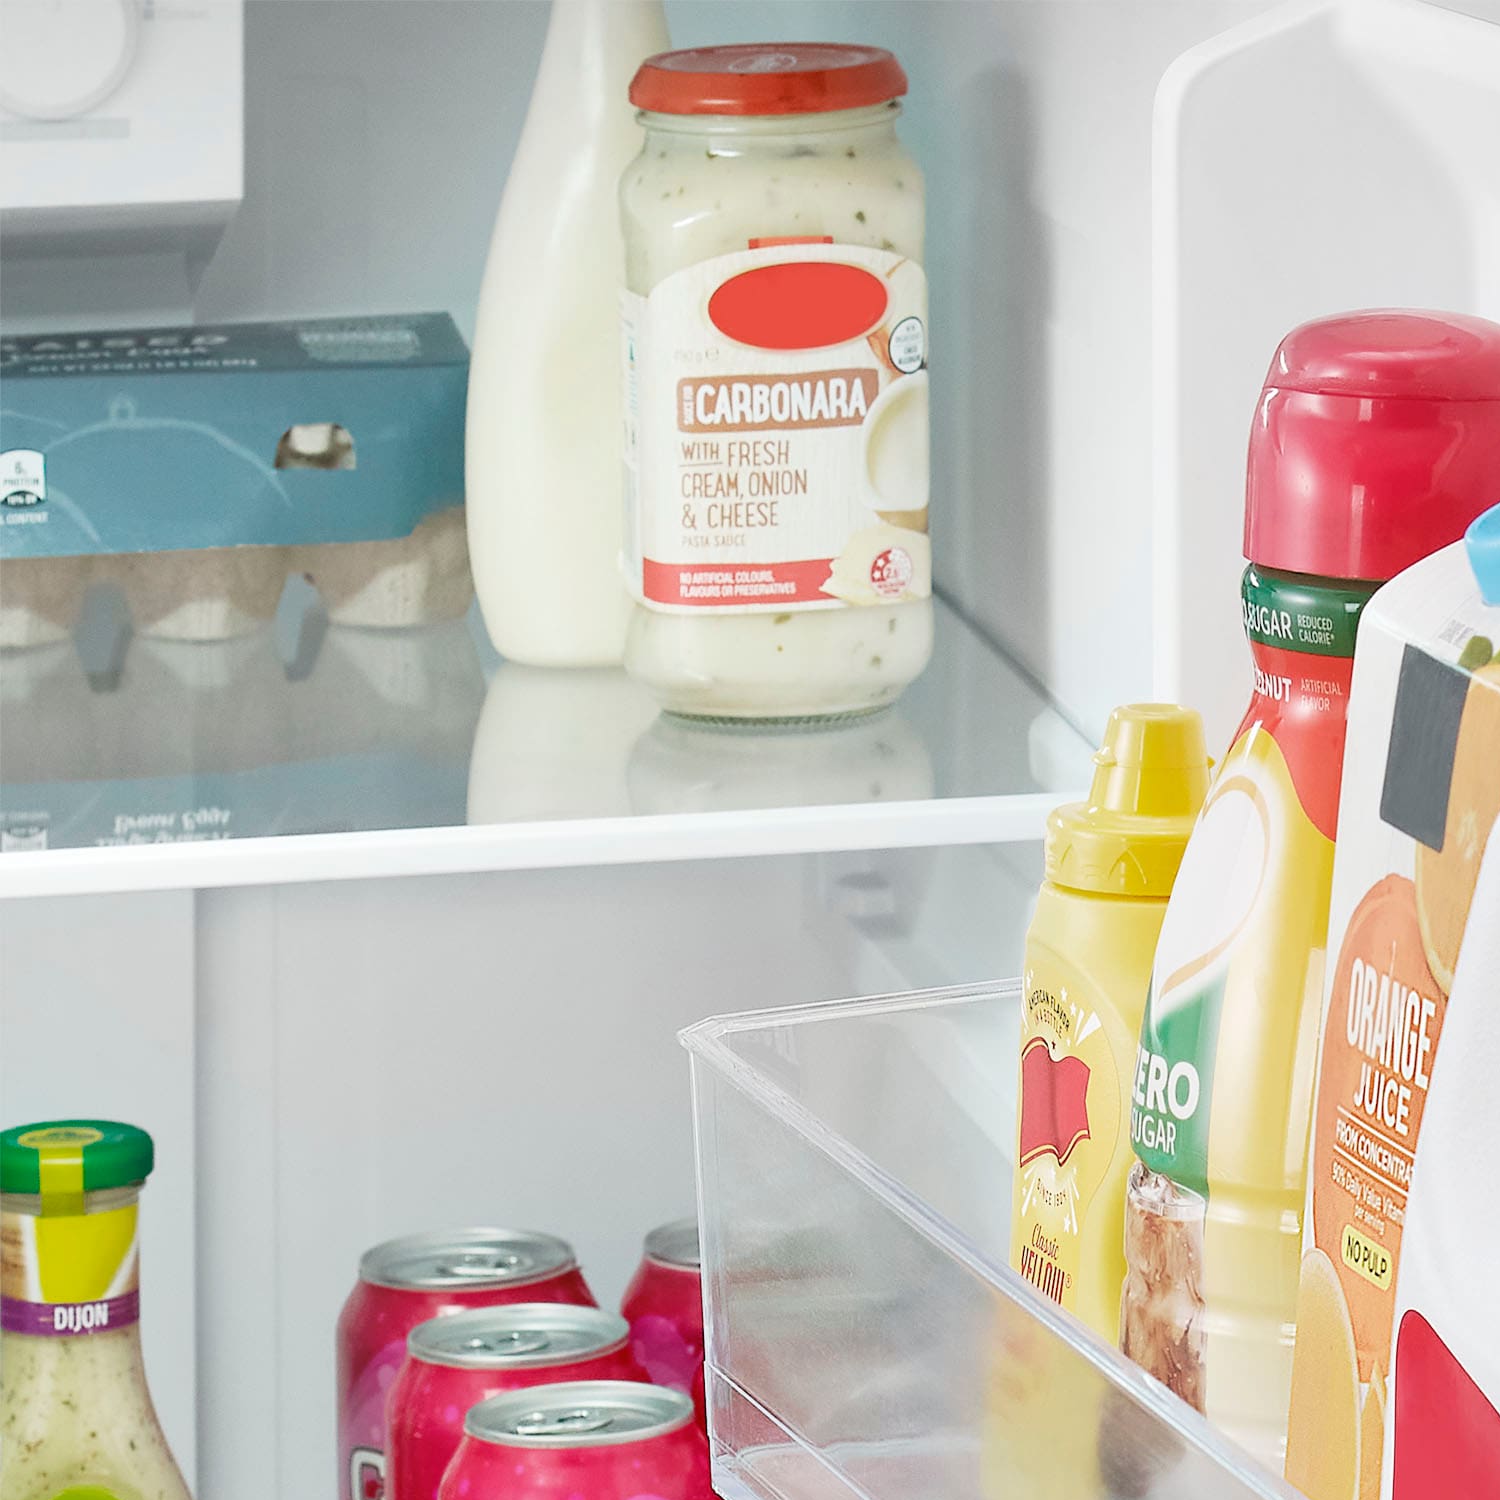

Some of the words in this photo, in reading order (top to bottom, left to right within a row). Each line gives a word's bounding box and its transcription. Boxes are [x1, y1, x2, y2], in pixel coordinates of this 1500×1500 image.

[696, 378, 867, 424] CARBONARA
[682, 441, 719, 460] WITH
[728, 439, 789, 466] FRESH
[682, 471, 744, 499] CREAM,
[749, 468, 807, 496] ONION
[682, 503, 697, 529] &
[707, 500, 778, 528] CHEESE
[682, 535, 709, 547] PASTA
[714, 534, 745, 546] SAUCE
[680, 584, 719, 597] FLAVOURS
[721, 584, 733, 597] OR
[735, 582, 796, 596] PRESERVATIVES
[693, 572, 733, 583] ARTIFICIAL
[1297, 614, 1332, 630] REDUCED
[1300, 678, 1342, 696] ARTIFICIAL
[1301, 695, 1330, 711] FLAVOR
[1050, 994, 1070, 1033] FLAVOR
[1347, 957, 1436, 1090] ORANGE
[1353, 1062, 1411, 1137] JUICE
[1335, 1118, 1358, 1150] FROM
[1345, 1171, 1361, 1202] Daily
[1362, 1182, 1382, 1213] Value
[1031, 1223, 1059, 1261] Classic
[1346, 1235, 1361, 1263] NO
[1361, 1245, 1388, 1280] PULP
[53, 1303, 108, 1333] DIJON
